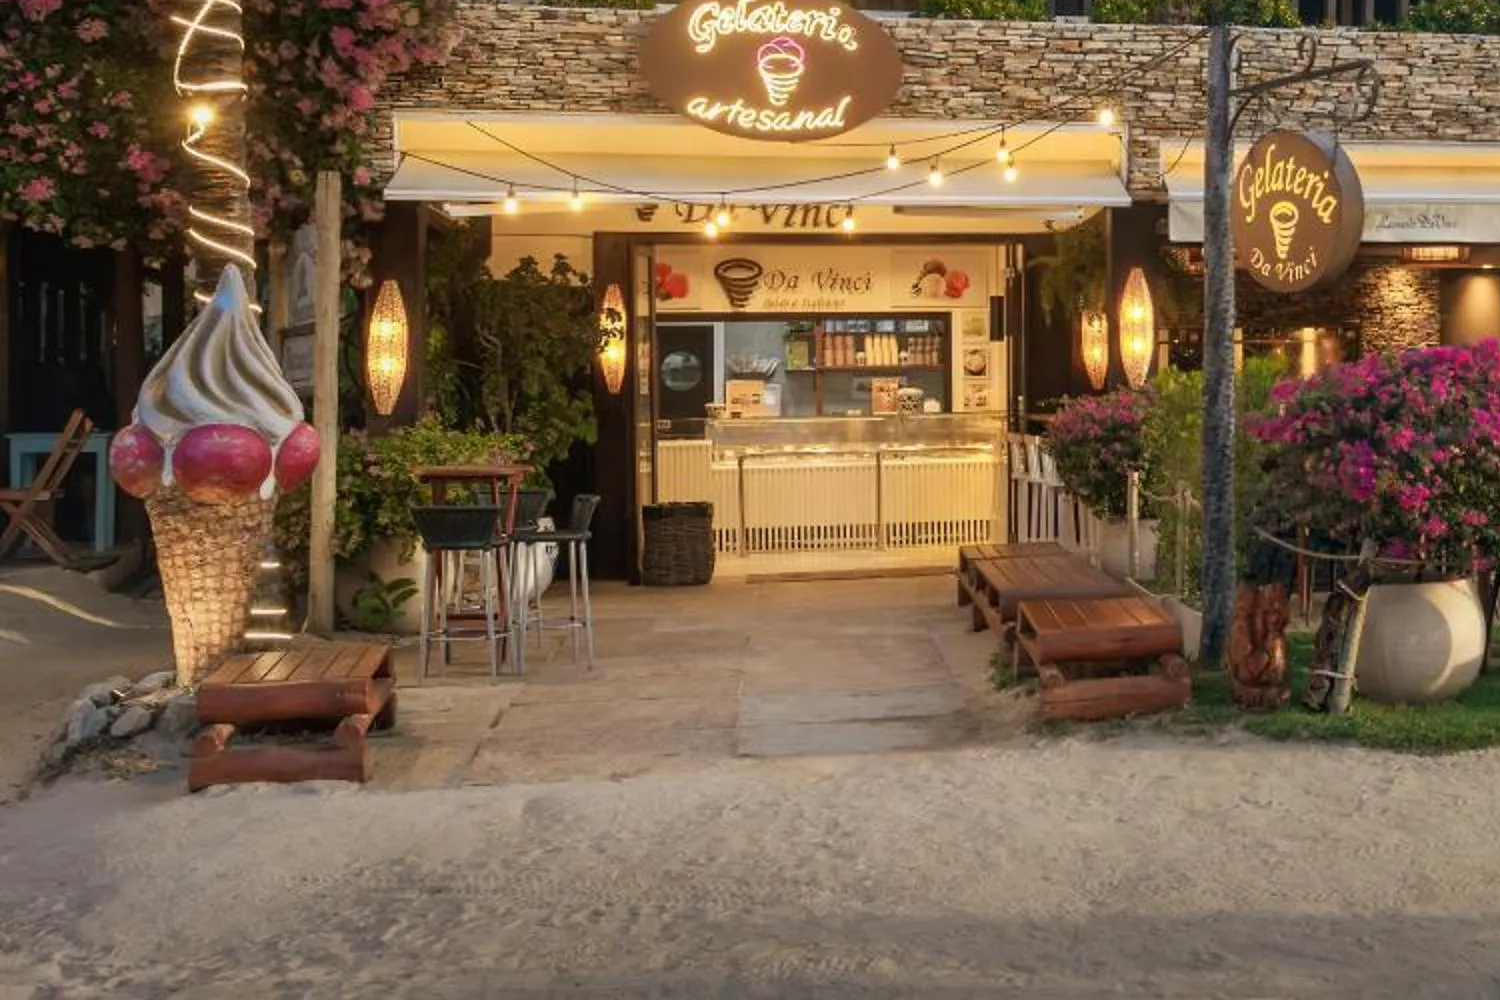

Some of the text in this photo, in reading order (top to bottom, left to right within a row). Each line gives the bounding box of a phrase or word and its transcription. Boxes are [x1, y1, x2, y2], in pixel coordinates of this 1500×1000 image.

[687, 96, 851, 131] artesanal
[1238, 144, 1338, 223] Gelateria
[763, 268, 871, 294] Da Vinci
[1250, 245, 1318, 284] Da Vinci
